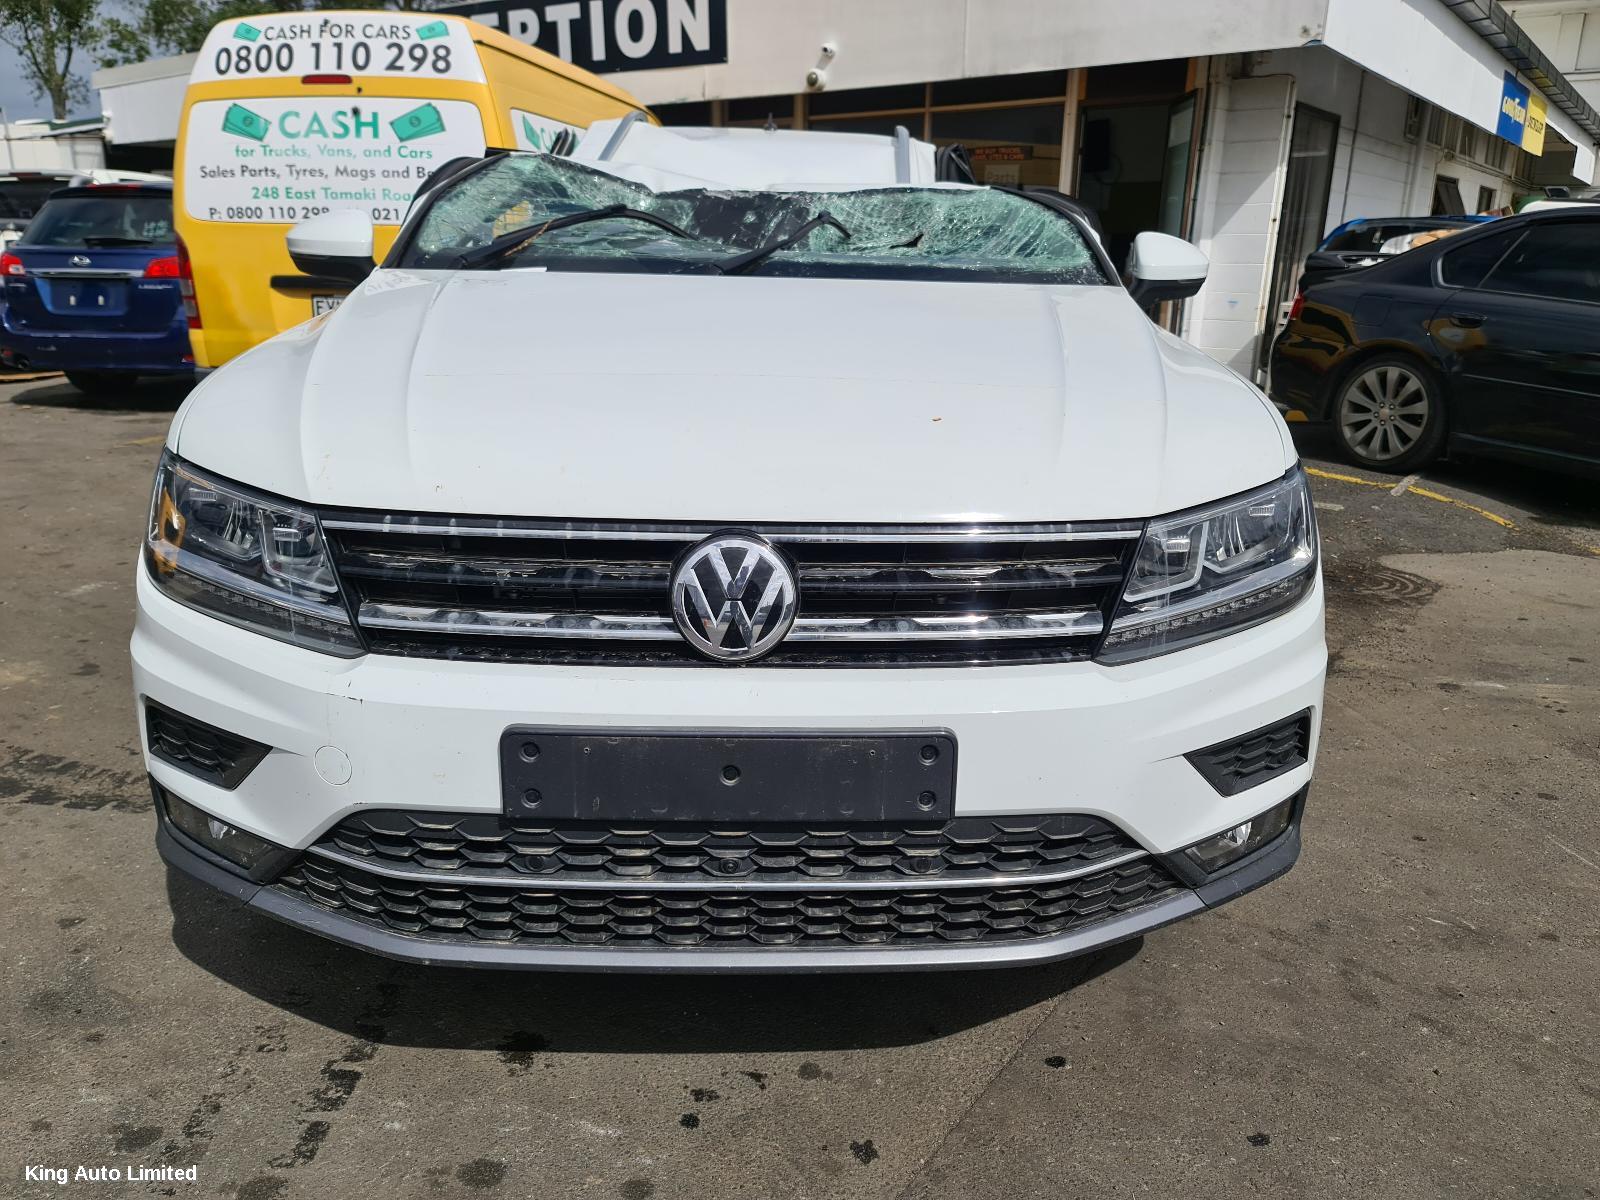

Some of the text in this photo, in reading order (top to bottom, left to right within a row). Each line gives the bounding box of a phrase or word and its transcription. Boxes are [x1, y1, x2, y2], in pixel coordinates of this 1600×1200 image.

[264, 23, 411, 41] CASH FOR CARS
[470, 0, 711, 64] PTION
[215, 41, 451, 75] 0800 110 298
[278, 110, 379, 139] CASH
[235, 144, 433, 159] for Trucks, Vans, and Cars
[199, 165, 235, 178] Sales
[240, 165, 280, 179] Parts,
[286, 164, 328, 180] Tyres,
[335, 165, 376, 181] Mags
[381, 166, 410, 179] and
[251, 186, 280, 199] 248
[285, 187, 316, 200] East
[321, 187, 376, 200] Tamaki
[226, 206, 263, 219] 0800
[269, 206, 296, 219] 110
[372, 208, 400, 220] 021
